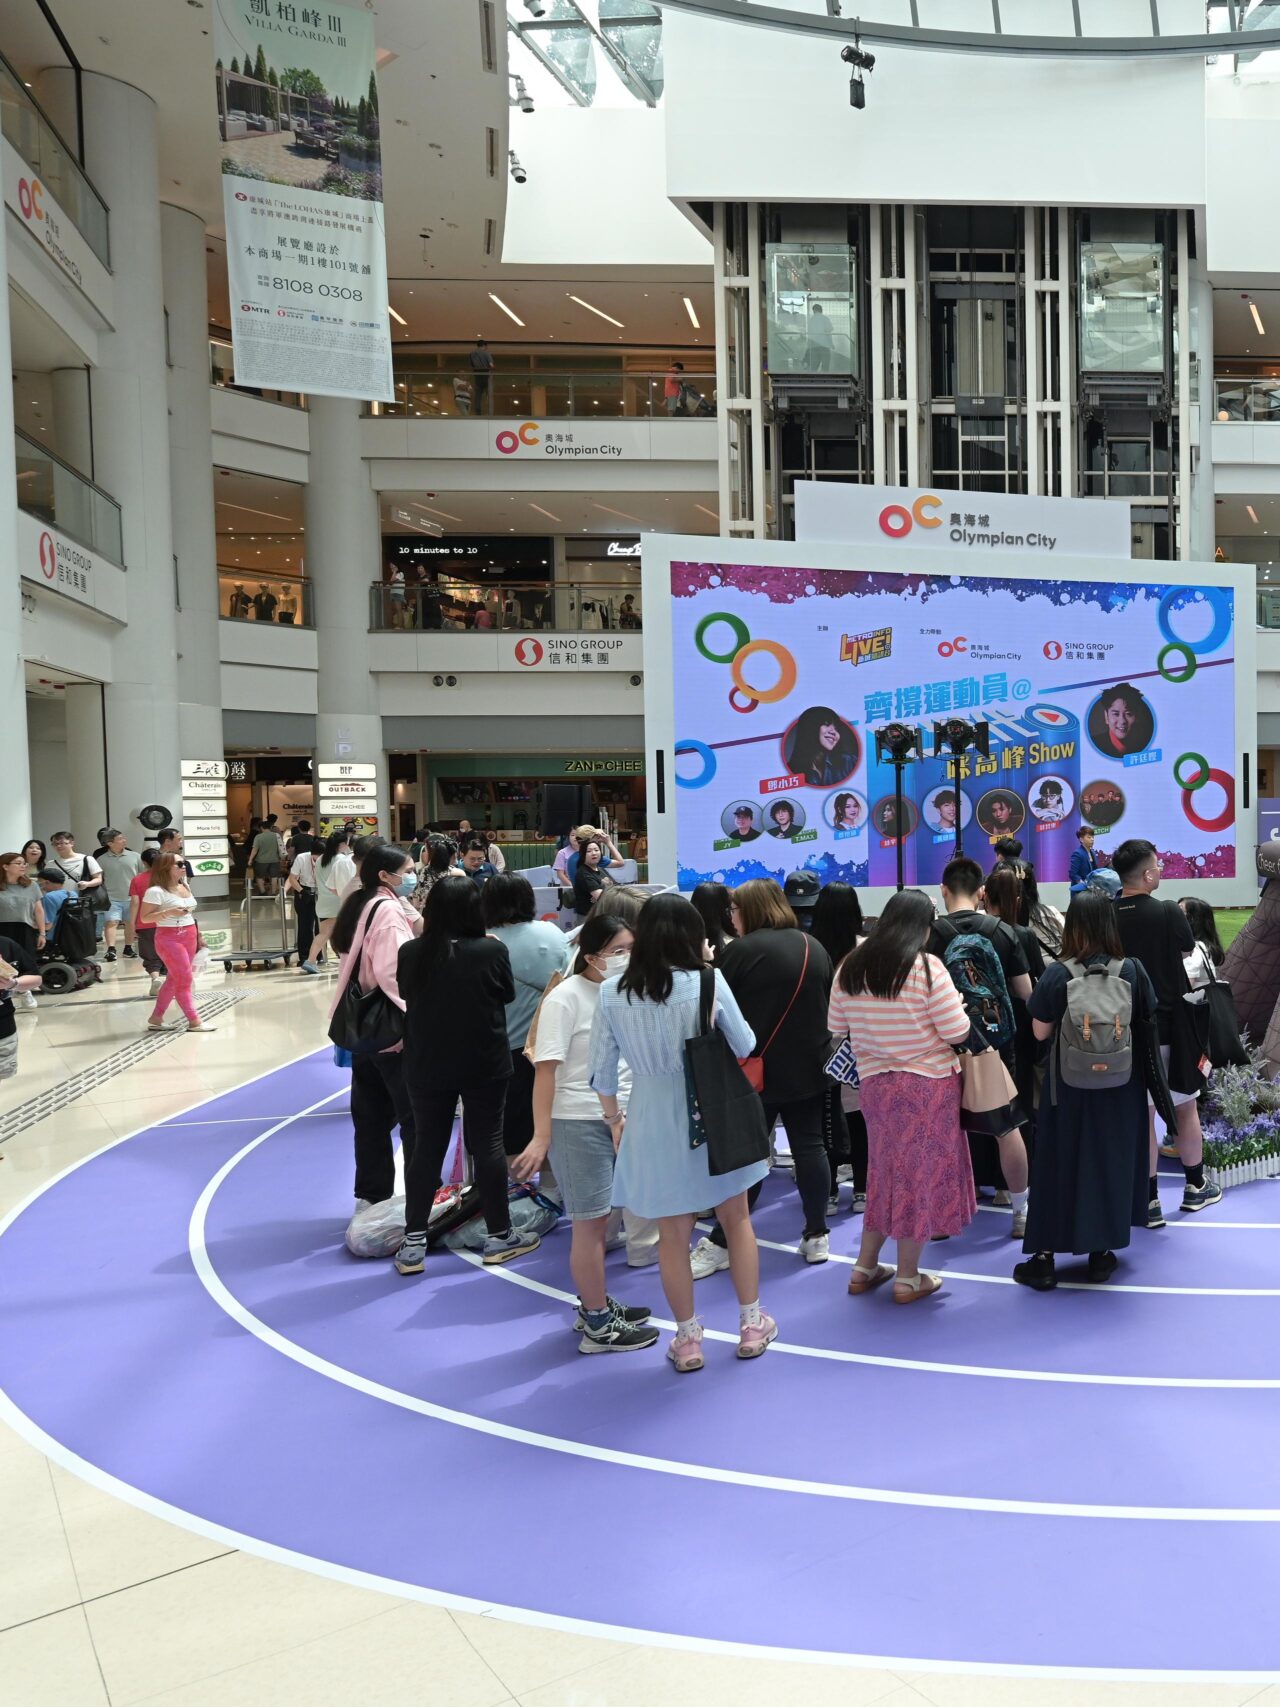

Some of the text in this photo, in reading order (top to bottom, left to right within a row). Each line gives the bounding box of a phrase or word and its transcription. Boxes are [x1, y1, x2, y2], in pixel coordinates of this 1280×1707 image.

[244, 14, 283, 33] VILLA
[287, 26, 334, 45] GARDA
[272, 277, 314, 295] 8108
[318, 284, 363, 302] 0308
[251, 307, 270, 315] MTR
[545, 433, 574, 443] 奧海城
[545, 445, 622, 456] Olympian City
[950, 513, 990, 527] 奧海城
[950, 529, 1057, 549] Olympian City
[56, 542, 92, 572] SINO GROUP
[548, 640, 623, 649] SINO GROUP
[1086, 643, 1114, 651] GROUP
[548, 653, 609, 665] 信和集團
[970, 652, 1022, 661] Olympian City
[1065, 651, 1105, 661] 信和集團
[1029, 741, 1075, 764] Show
[565, 761, 642, 772] ZAN CHEE
